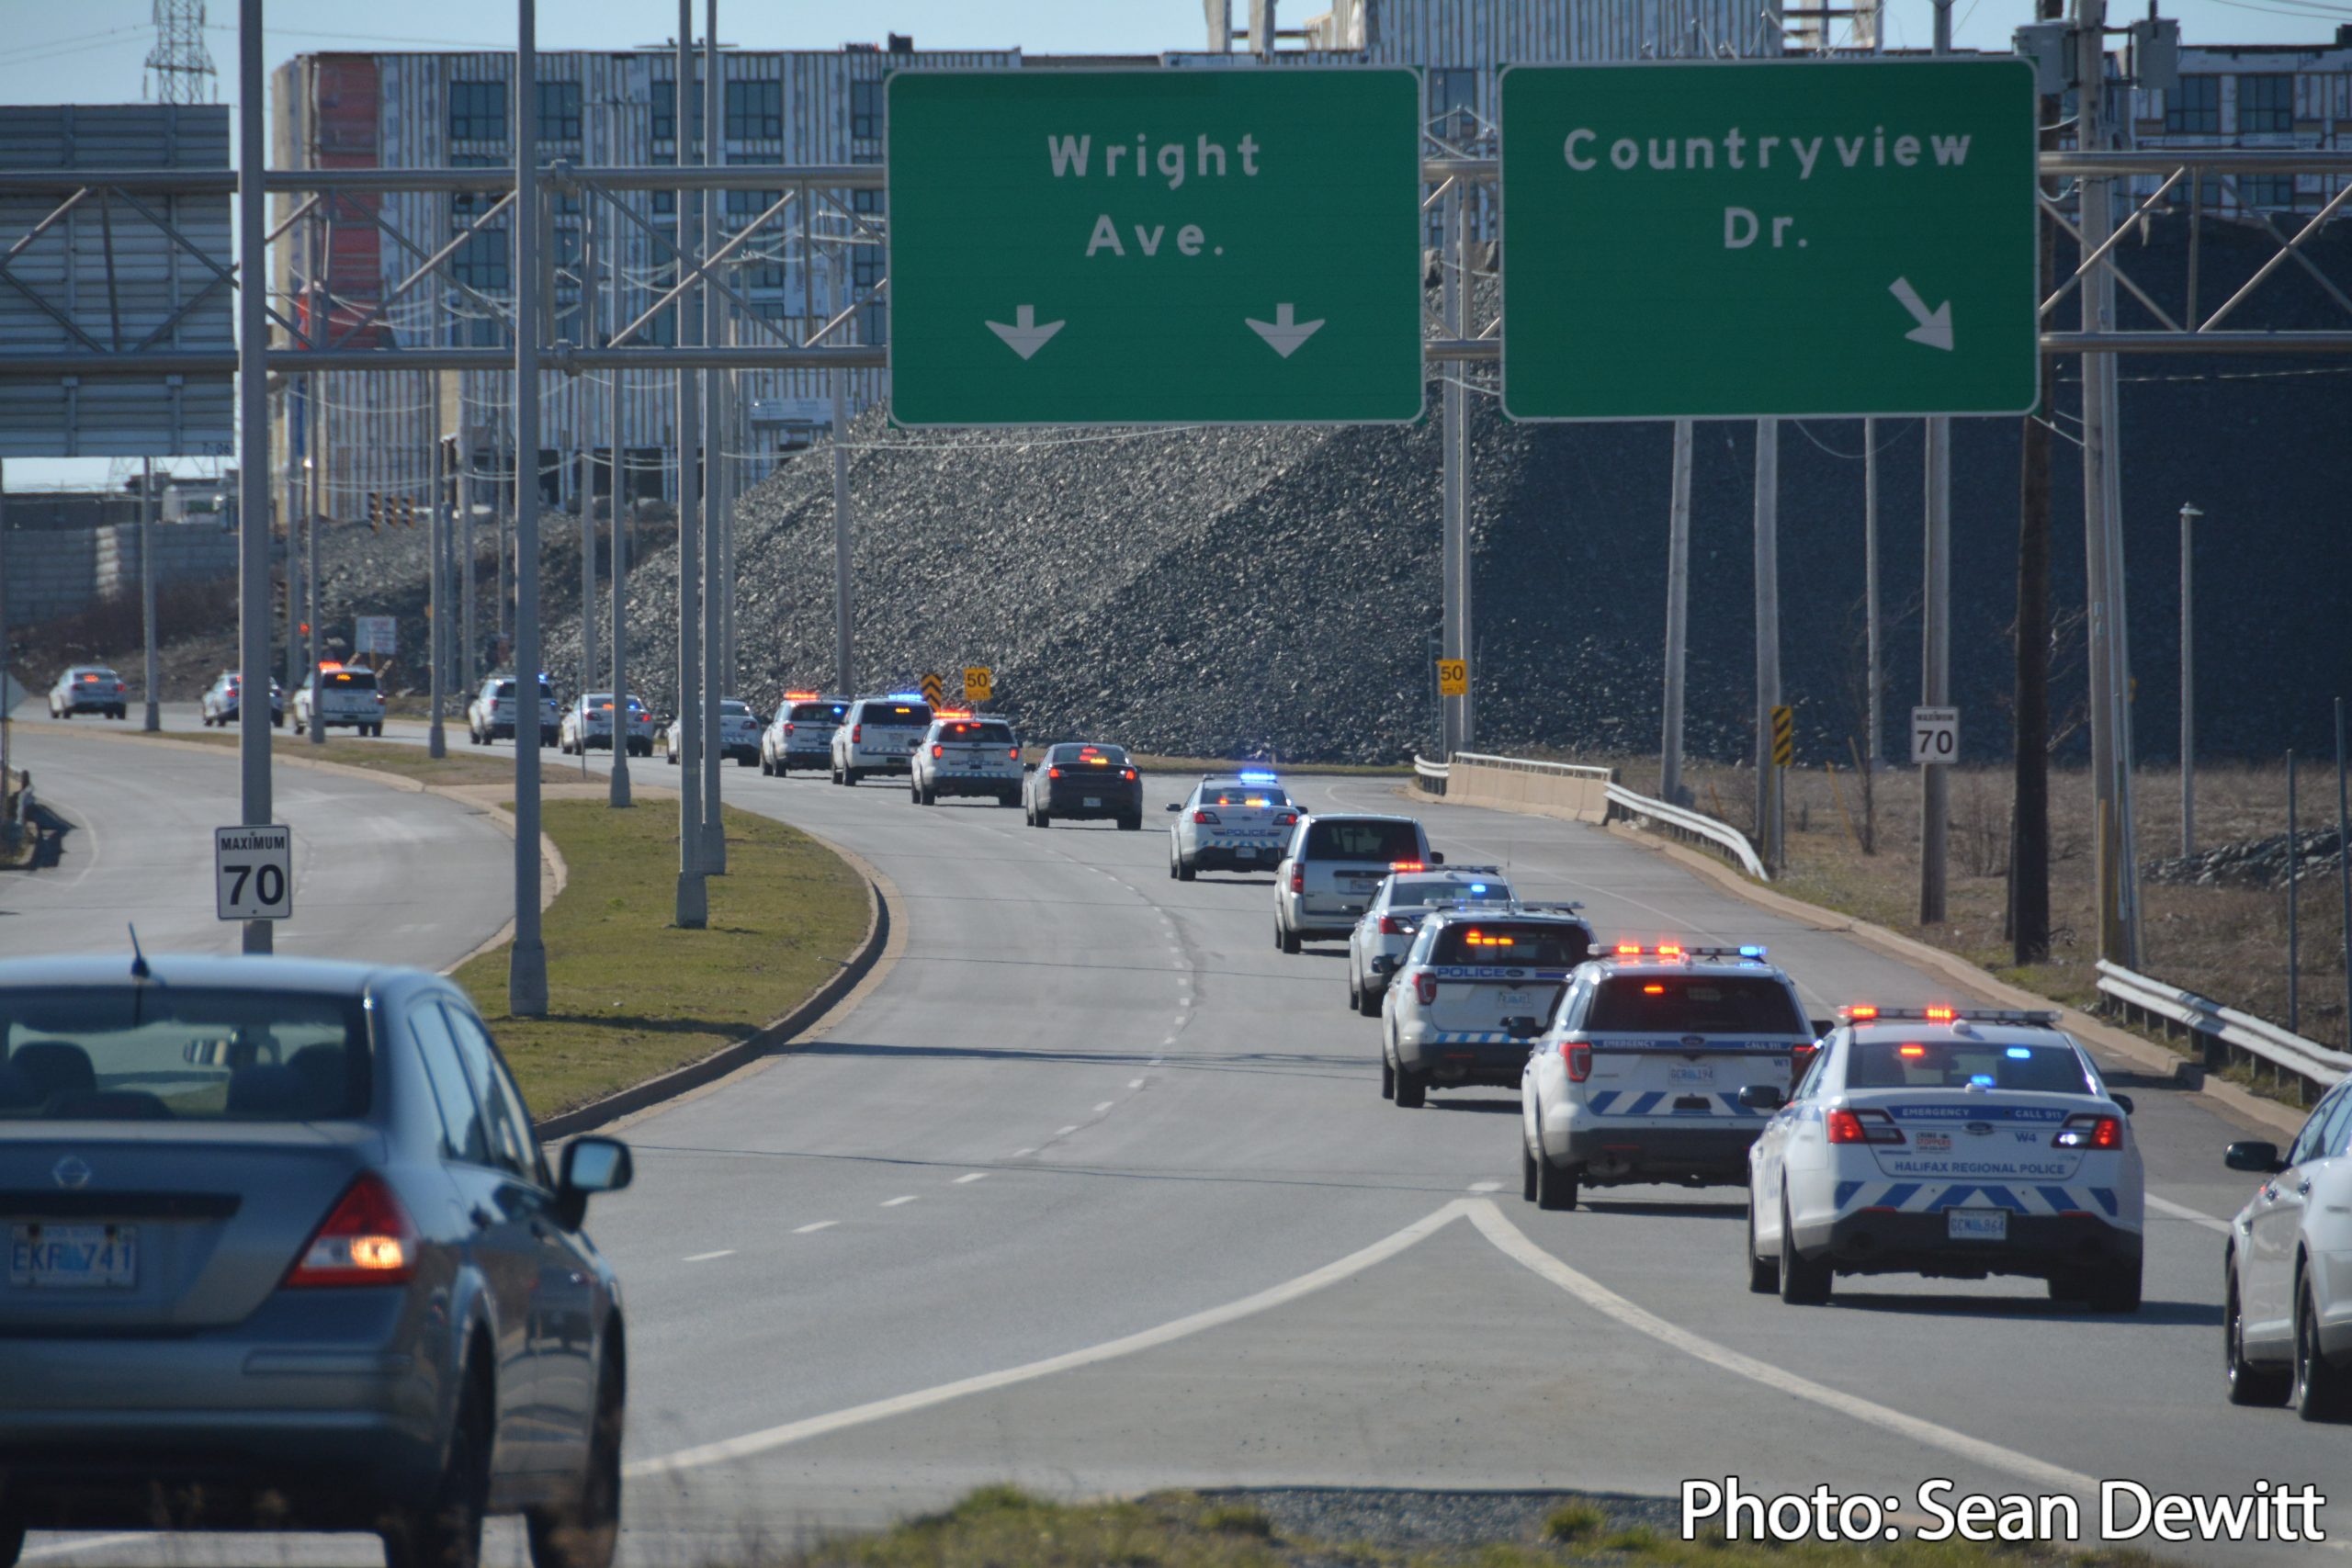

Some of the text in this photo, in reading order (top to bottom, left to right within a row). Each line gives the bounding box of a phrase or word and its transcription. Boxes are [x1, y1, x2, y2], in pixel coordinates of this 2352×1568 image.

[1563, 125, 1972, 180] Countryview
[1047, 132, 1260, 190] Wright
[1724, 206, 1808, 248] Dr.
[1085, 214, 1224, 256] Ave.
[967, 672, 988, 688] 50
[1440, 665, 1464, 682] 50
[1917, 729, 1953, 754] 70
[1227, 829, 1266, 837] POLICE
[220, 836, 285, 851] MAXIMUM
[223, 863, 285, 906] 70
[1437, 967, 1504, 977] POLICE
[1603, 1039, 1656, 1048] EMERGENCY
[1745, 1041, 1781, 1050] CALL 911
[1902, 1108, 1970, 1116] EMERGENCY
[2015, 1110, 2062, 1119] CALL 911
[2015, 1132, 2037, 1143] W4
[1894, 1161, 2065, 1174] HALIFAX REGIONAL POLICE
[82, 1243, 131, 1270] 741
